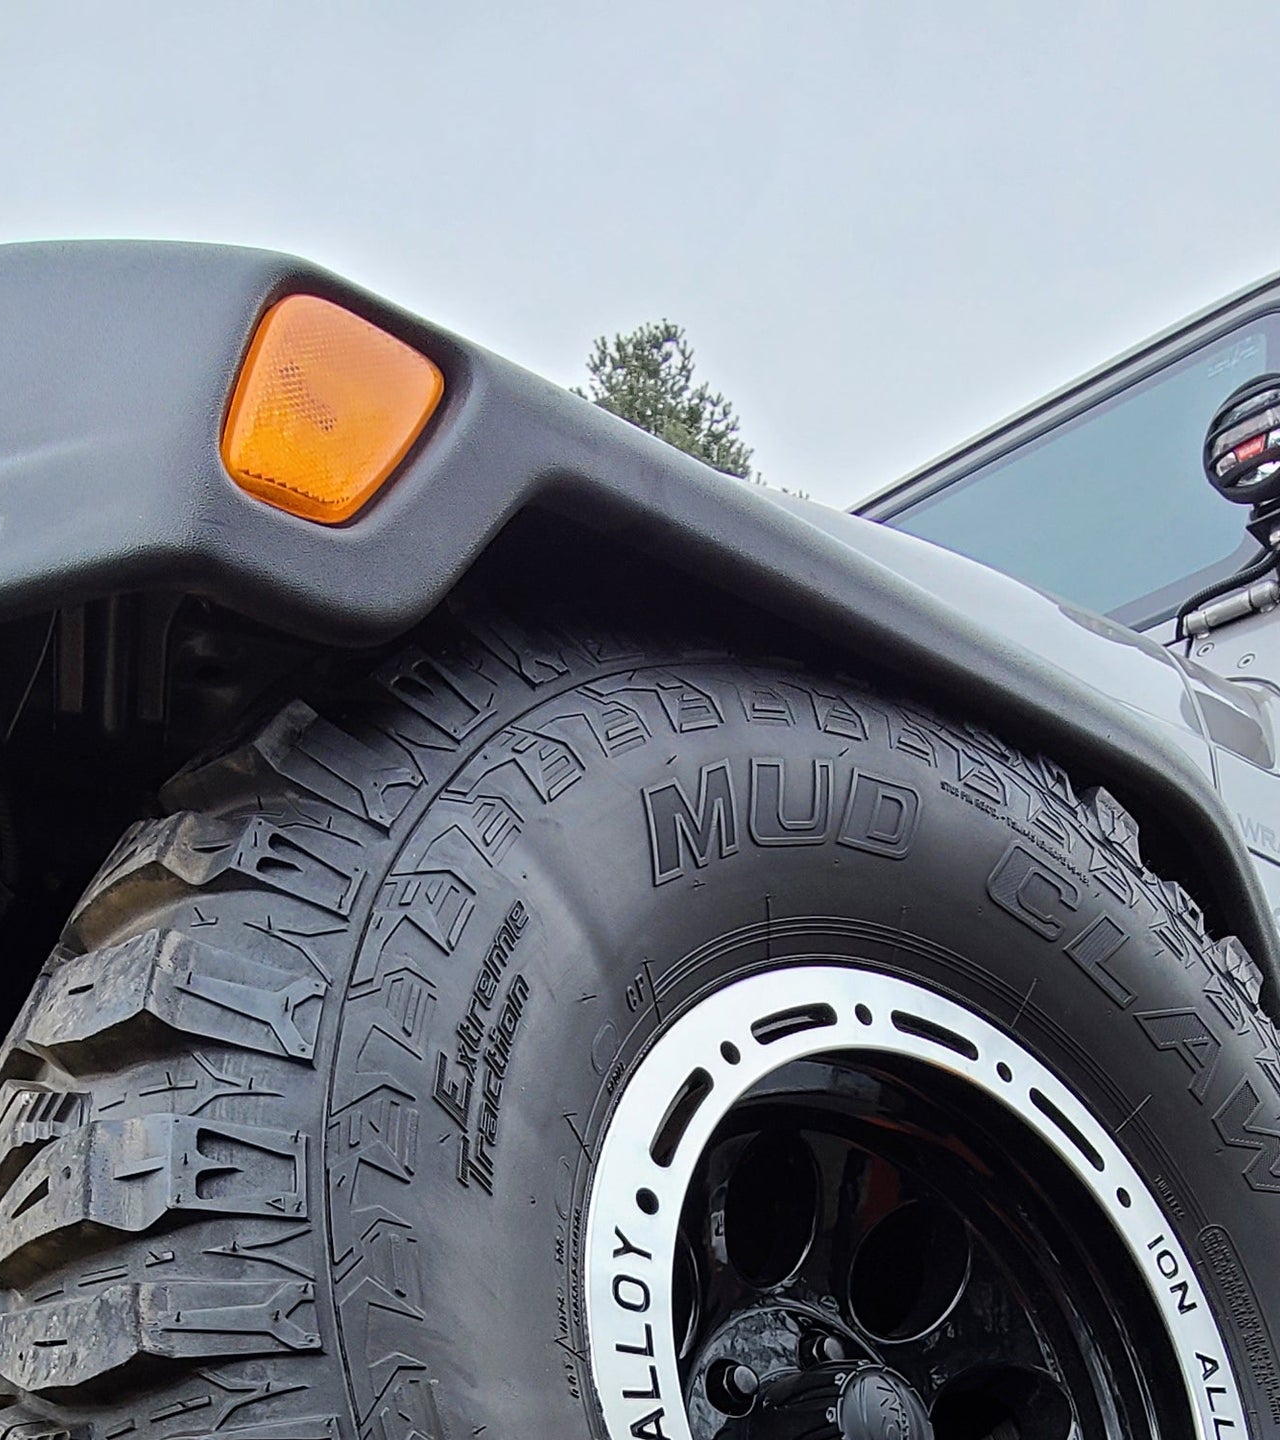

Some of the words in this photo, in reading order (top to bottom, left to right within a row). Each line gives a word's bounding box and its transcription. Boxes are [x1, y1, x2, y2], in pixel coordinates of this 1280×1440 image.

[641, 757, 923, 889] MUD
[432, 899, 529, 1129] Extreme
[455, 973, 530, 1196] Traction
[1146, 1233, 1198, 1318] ION
